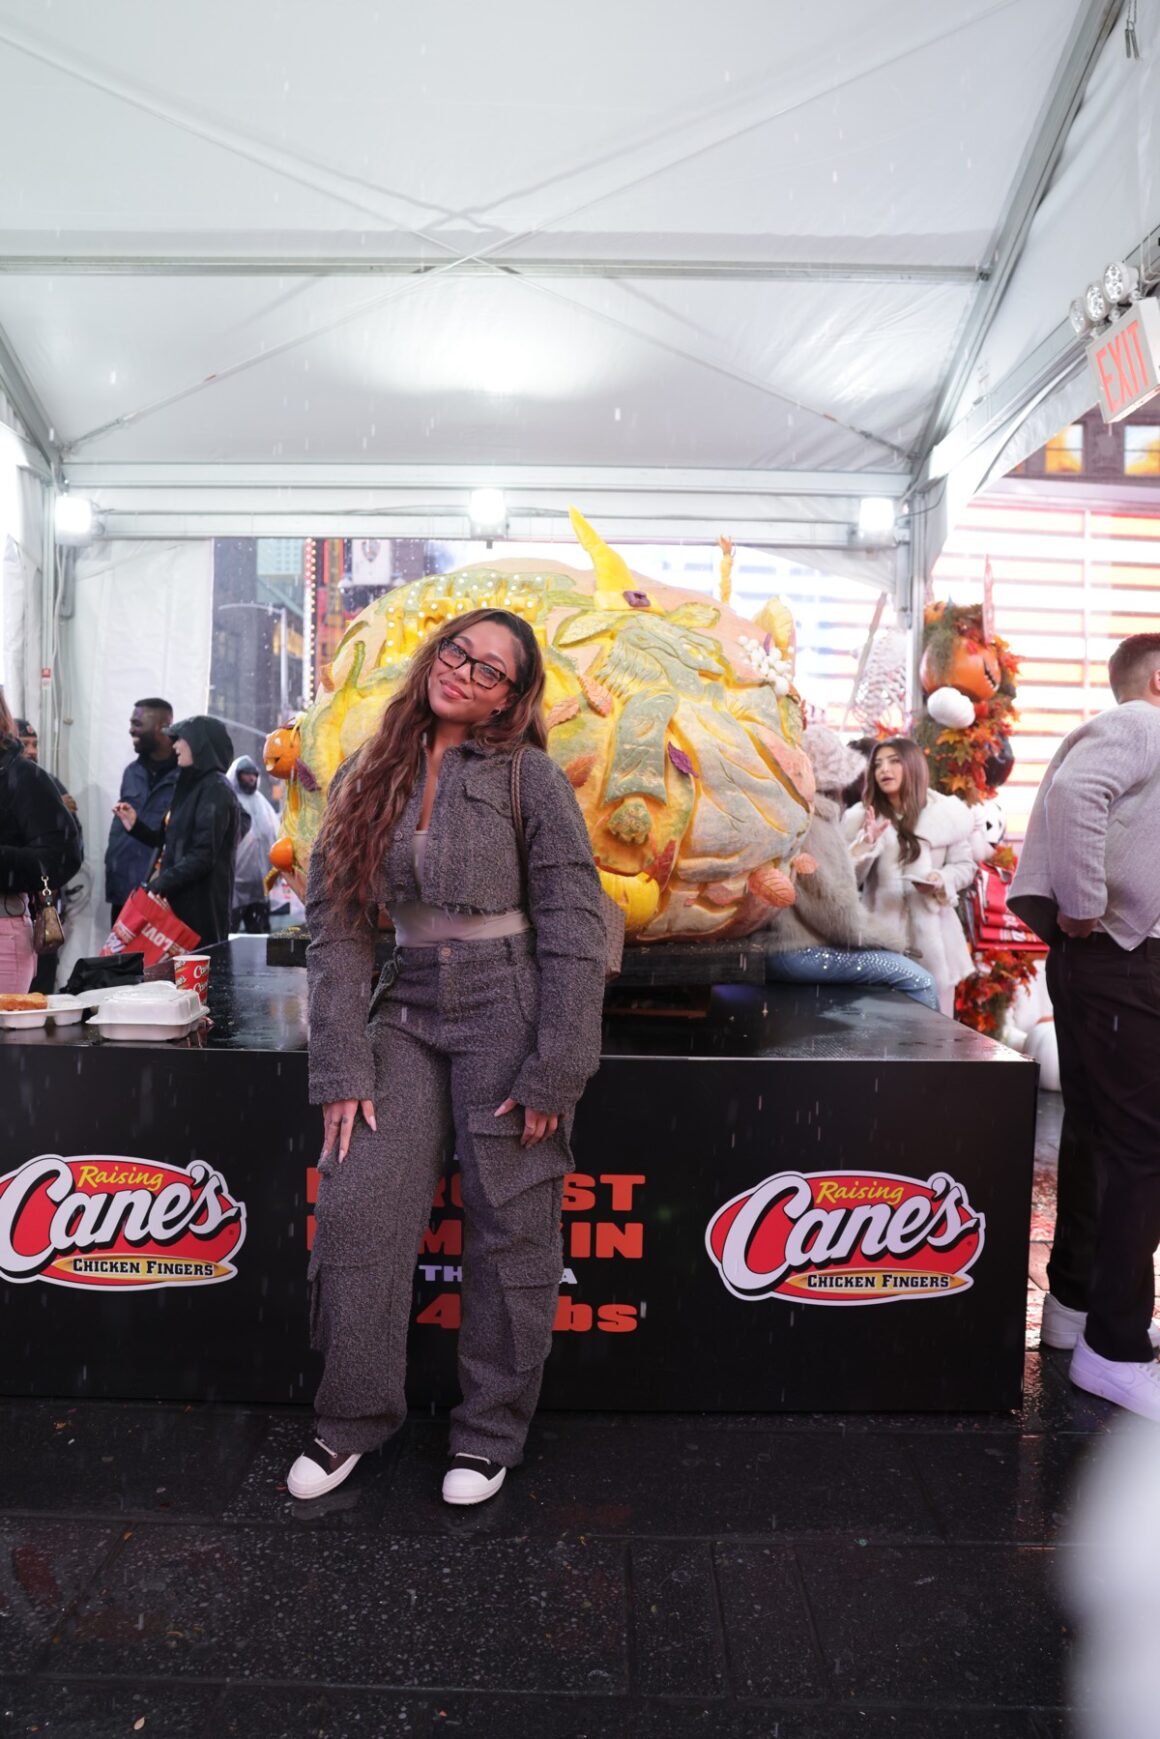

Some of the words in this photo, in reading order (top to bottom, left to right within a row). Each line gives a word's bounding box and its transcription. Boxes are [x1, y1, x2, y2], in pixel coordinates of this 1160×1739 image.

[1096, 320, 1149, 413] EXIT
[77, 1165, 164, 1191] Raising
[815, 1181, 904, 1205] Raising
[0, 1158, 240, 1273] Cane's
[722, 1174, 979, 1289] Cane's
[73, 1258, 140, 1274] CHICKEN
[146, 1260, 213, 1276] FINGERS
[807, 1274, 876, 1288] CHICKEN
[882, 1274, 949, 1288] FINGERS
